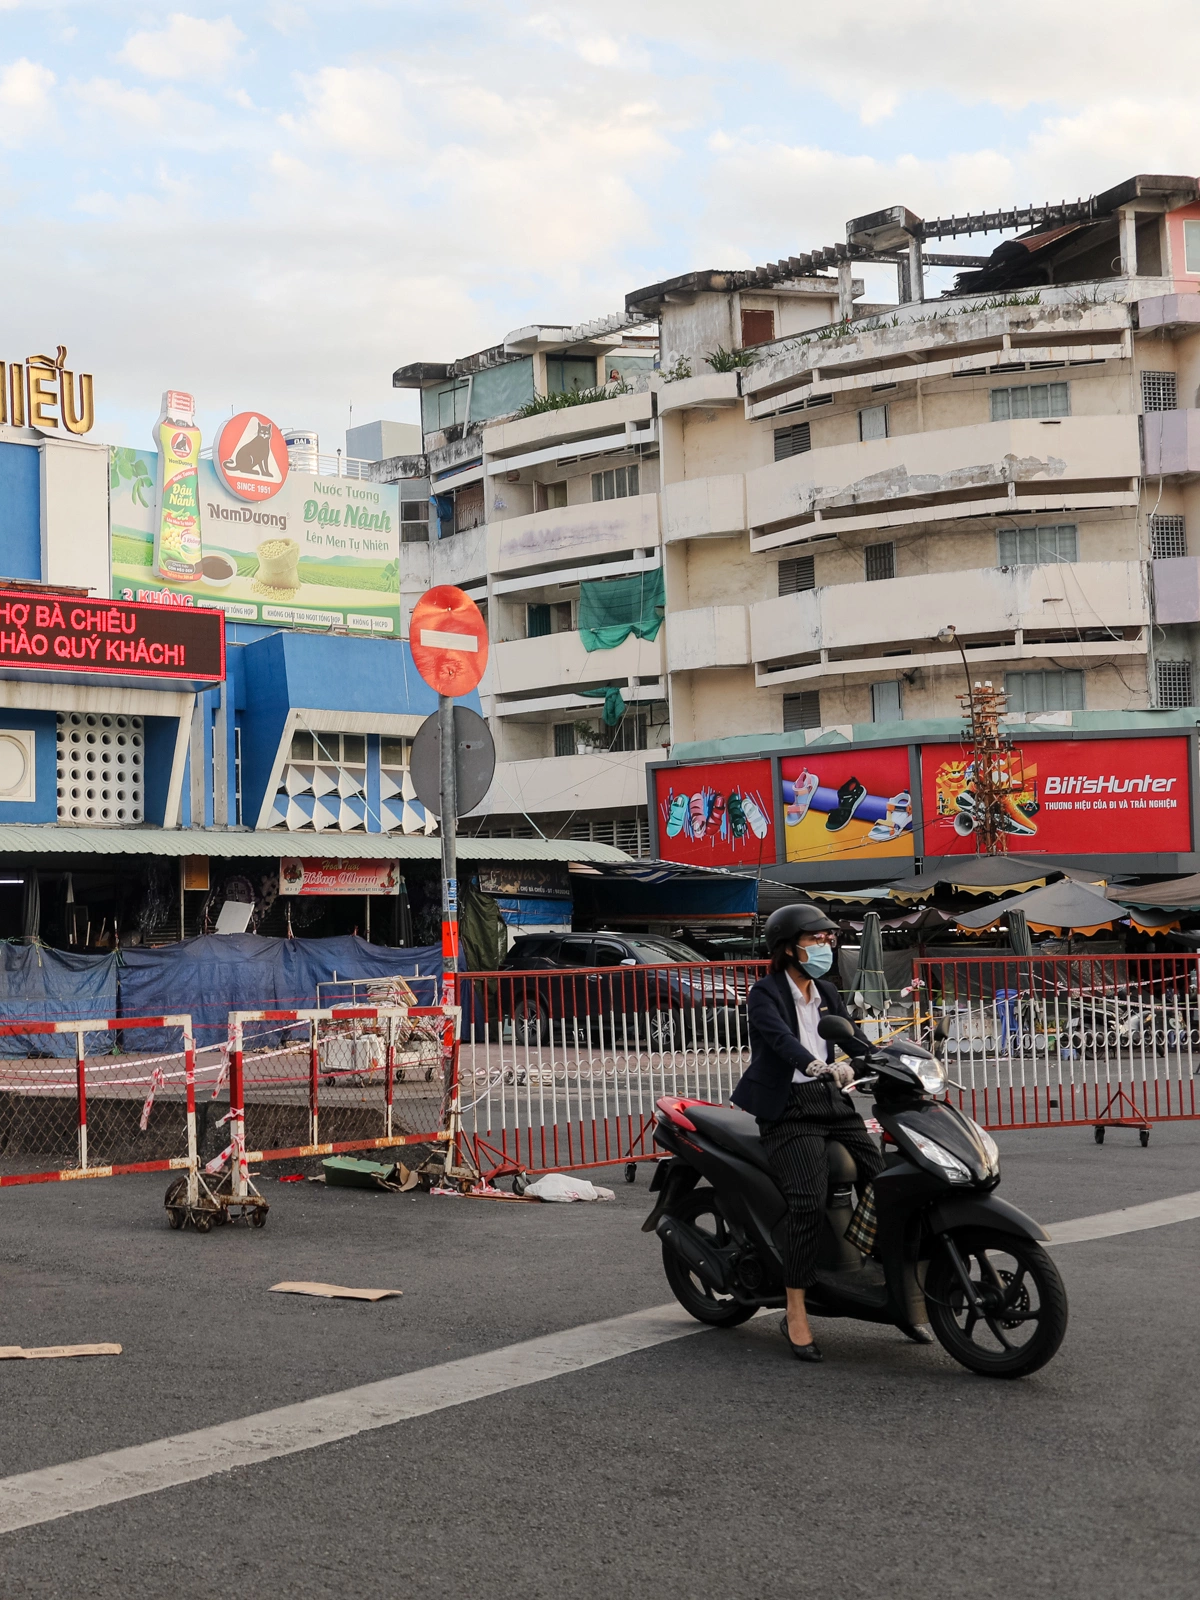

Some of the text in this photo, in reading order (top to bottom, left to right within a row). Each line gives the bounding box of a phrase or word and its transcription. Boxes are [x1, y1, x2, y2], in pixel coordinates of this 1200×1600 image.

[236, 482, 271, 494] SINCE 1951
[313, 481, 380, 504] Nước Tương
[207, 503, 287, 530] NamDương
[303, 500, 340, 529] Đậu
[306, 530, 389, 552] Lên Men Tự Nhiên
[138, 588, 194, 606] KHÔNG
[36, 602, 66, 629] BÀ
[54, 634, 100, 660] QUÝ
[106, 639, 186, 666] KHÁCH!
[1044, 774, 1176, 794] Biti'sHunter
[1045, 798, 1176, 810] THƯƠNG HIỆU CỦA ĐI VÀ TRẢI NGHIỆM
